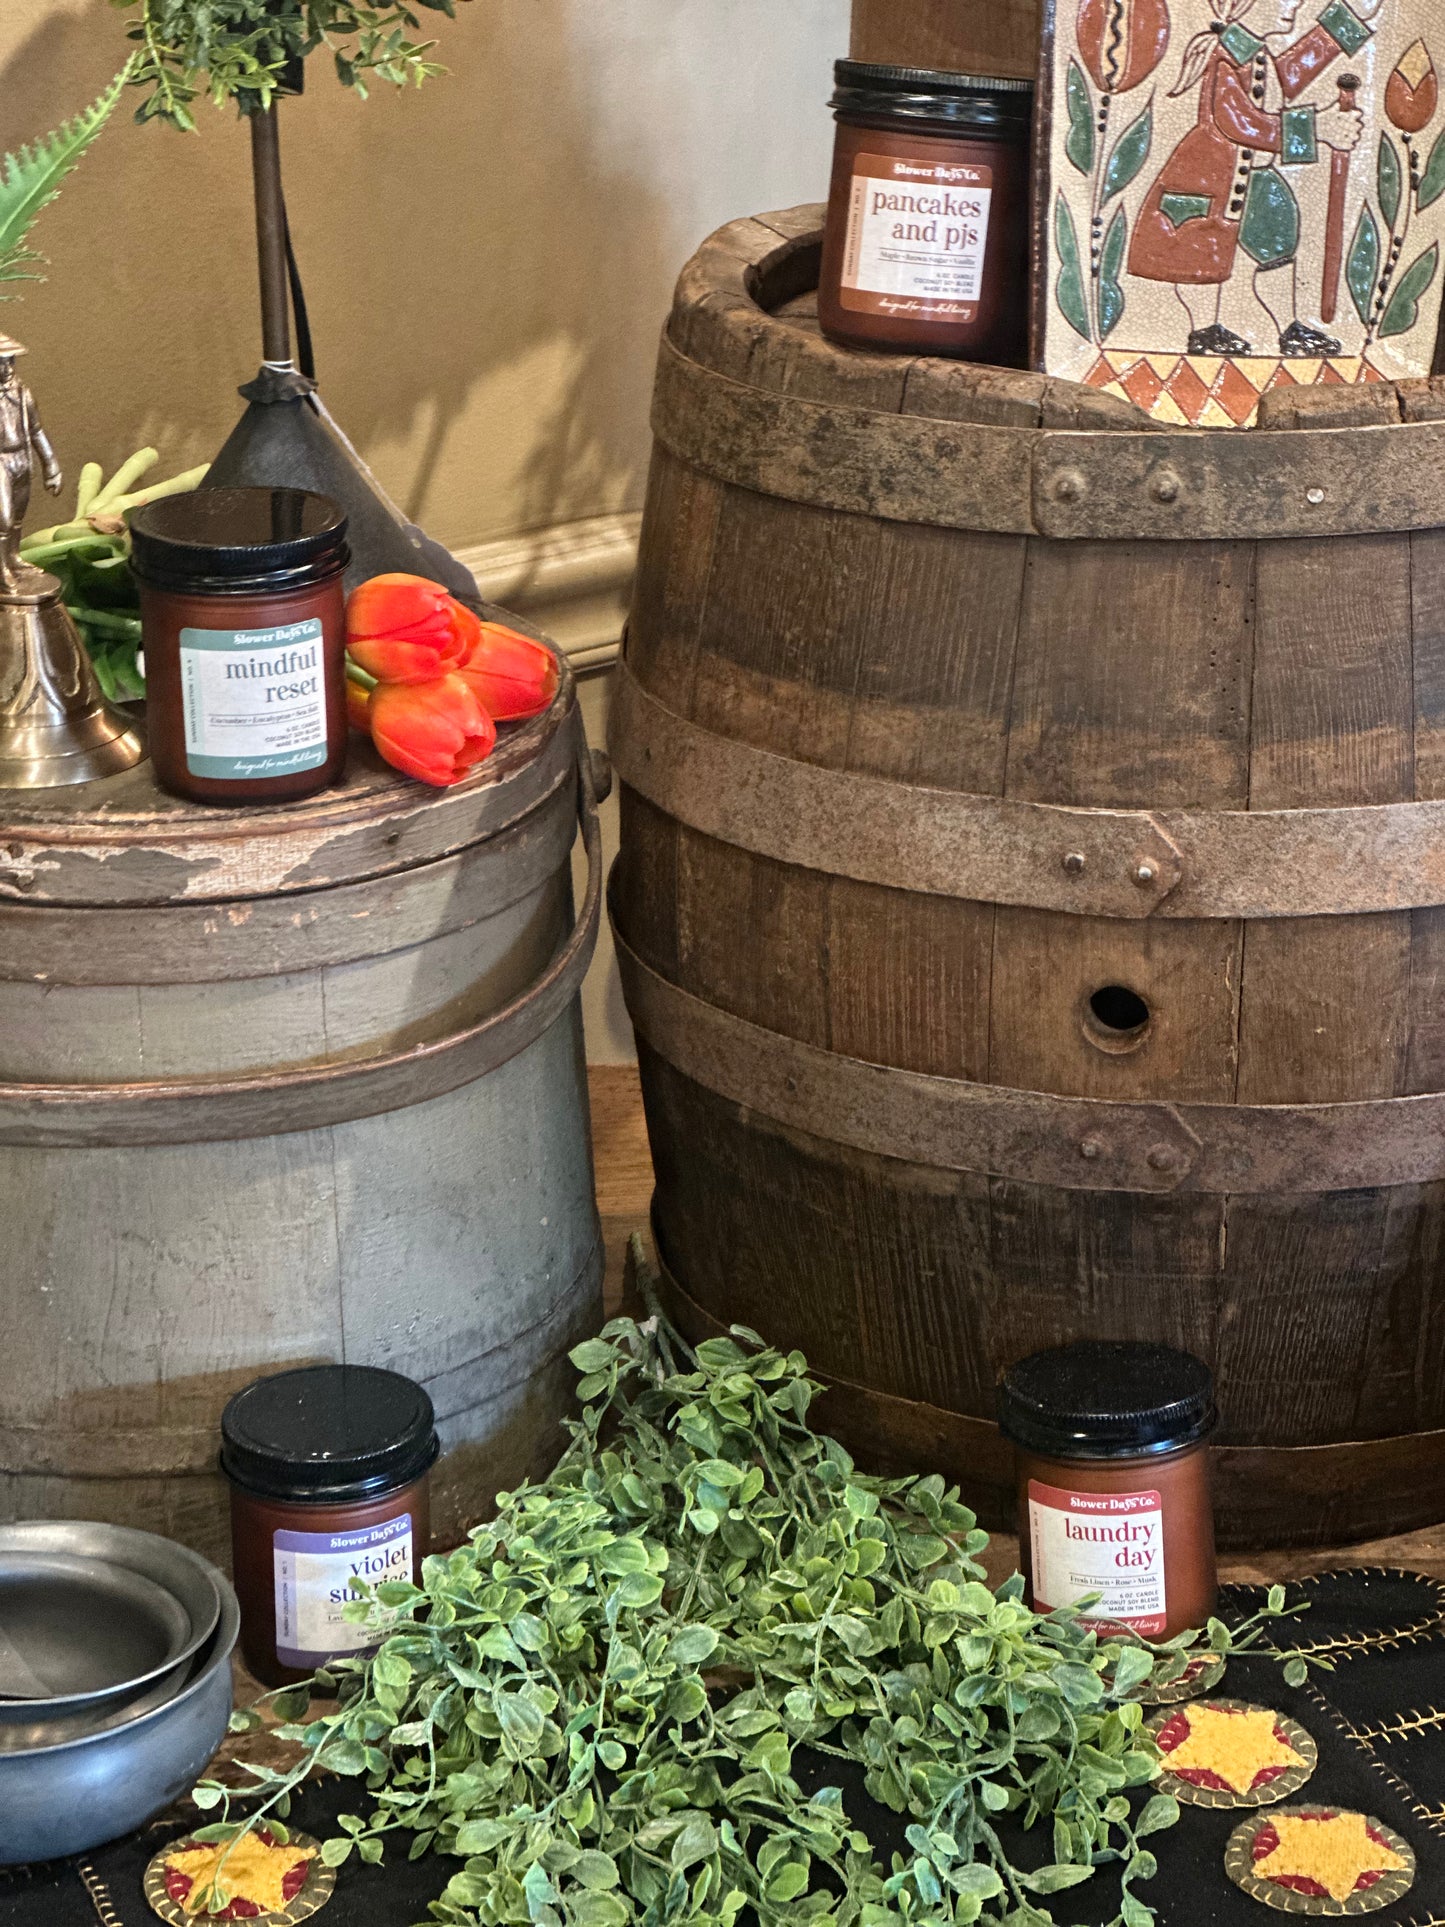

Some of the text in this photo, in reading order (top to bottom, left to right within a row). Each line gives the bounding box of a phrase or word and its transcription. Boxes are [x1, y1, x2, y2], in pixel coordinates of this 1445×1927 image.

[893, 162, 935, 177] Slower
[935, 166, 963, 181] Days
[871, 191, 982, 219] pancakes
[892, 220, 979, 252] and pjs
[880, 250, 901, 260] Maple
[233, 632, 275, 645] Slower
[275, 627, 302, 641] Days
[225, 645, 317, 679] mindful
[264, 676, 318, 704] reset
[1070, 1496, 1155, 1511] Slower Days Co.
[330, 1535, 369, 1549] Slower
[370, 1527, 396, 1542] Days
[1065, 1518, 1156, 1546] laundry
[350, 1545, 408, 1577] violet
[1115, 1546, 1158, 1571] day
[1070, 1574, 1157, 1586] Fresh Linen Rose Musk
[1099, 1598, 1126, 1606] OCONUT
[1136, 1590, 1158, 1598] CANDLE
[1097, 1621, 1108, 1631] for
[1138, 1618, 1160, 1632] living
